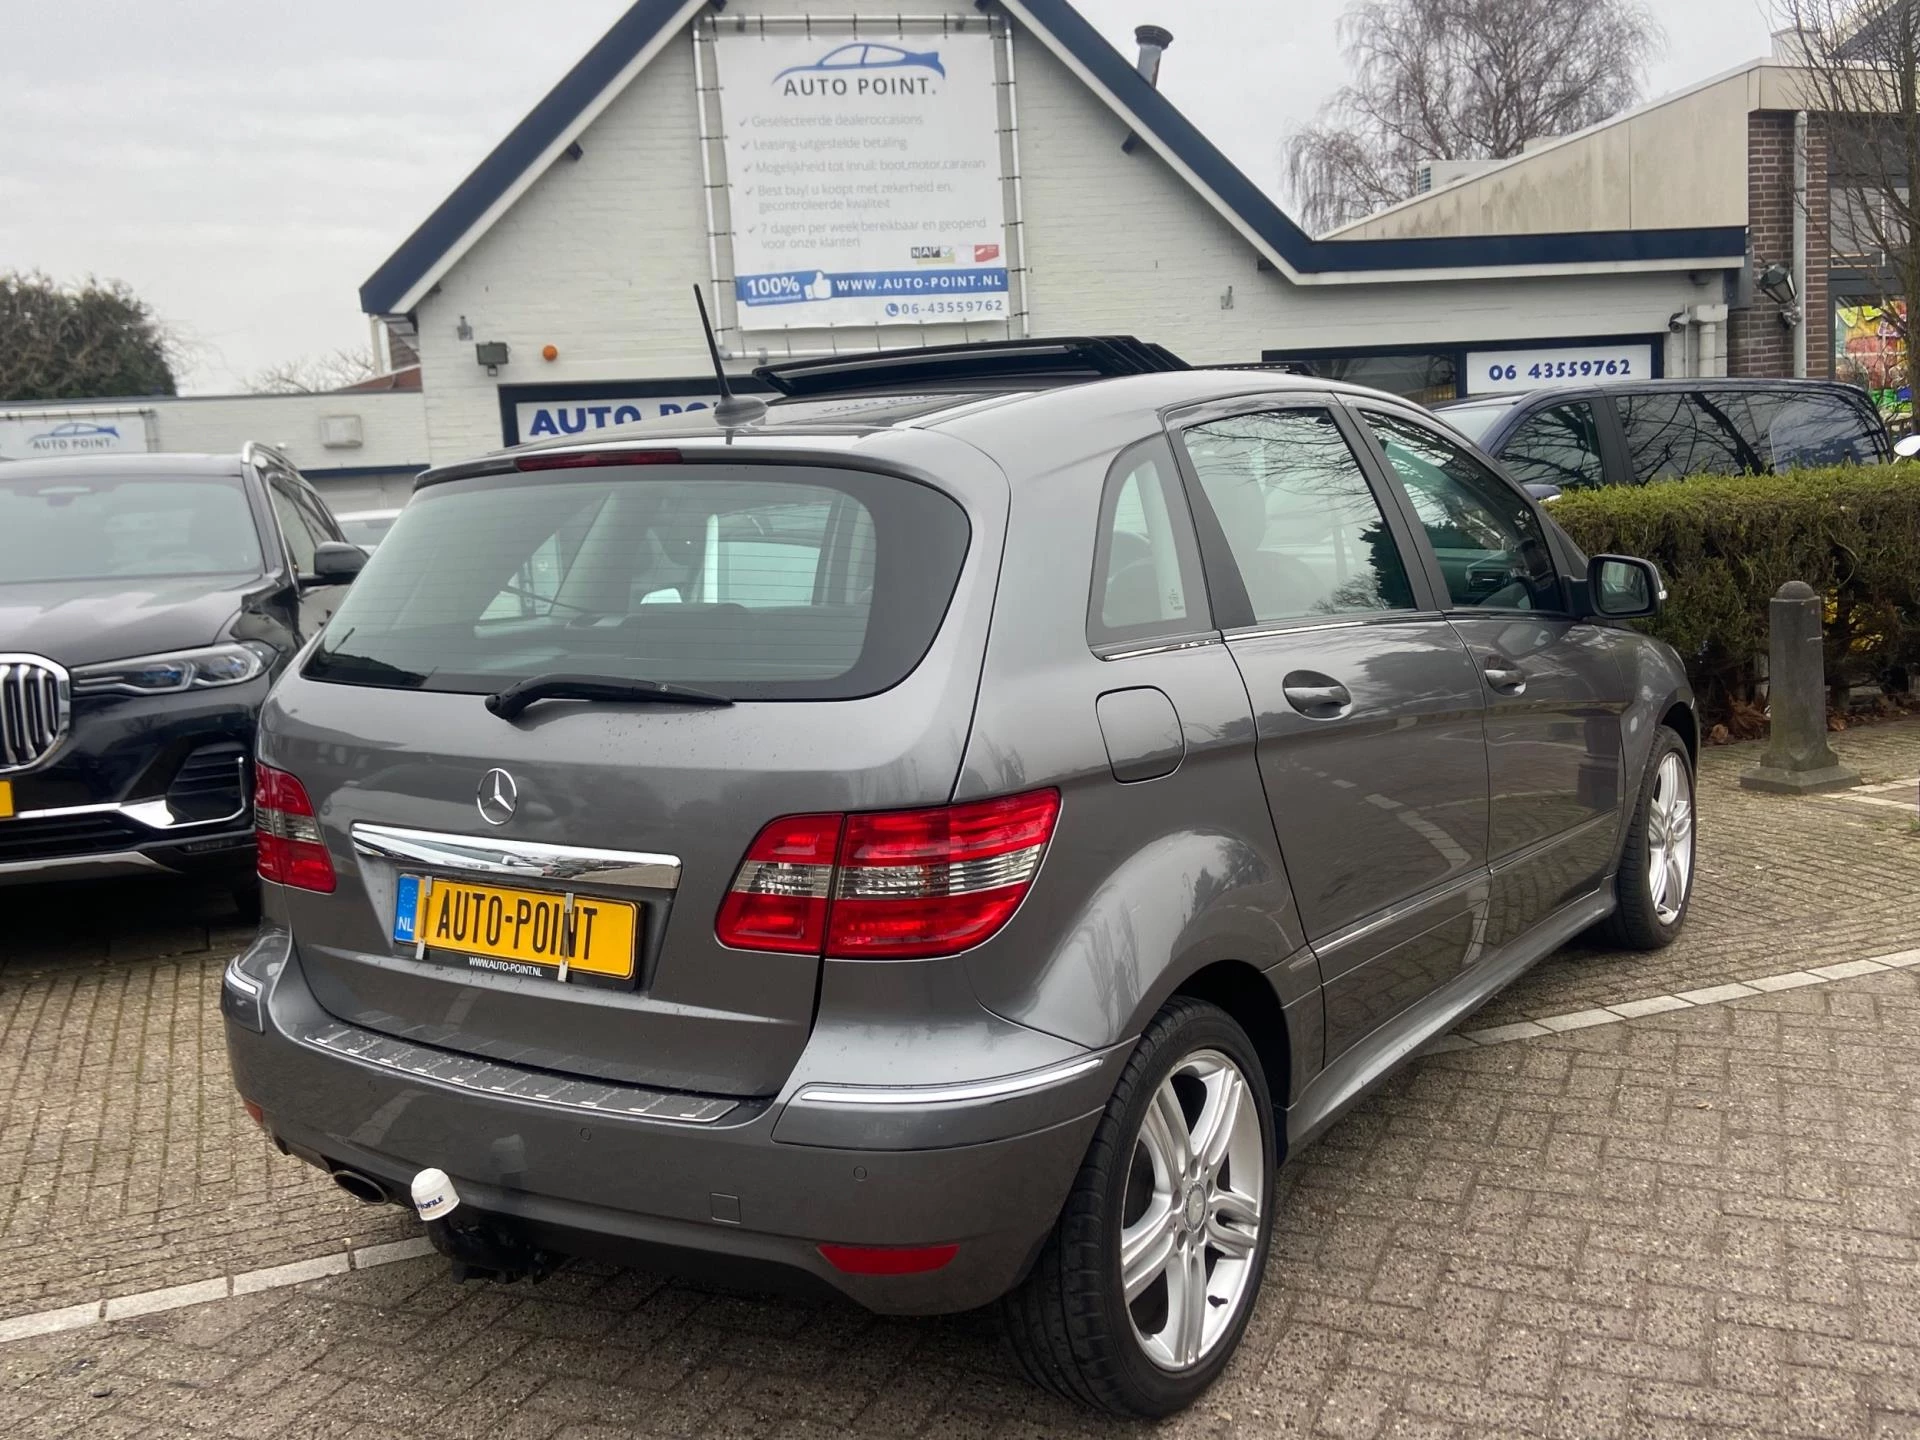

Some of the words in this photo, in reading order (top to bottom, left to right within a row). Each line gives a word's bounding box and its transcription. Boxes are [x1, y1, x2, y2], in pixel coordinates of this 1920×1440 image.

[783, 78, 848, 97] AUTO
[857, 76, 937, 96] POINT.
[856, 182, 878, 194] met
[881, 180, 934, 194] zekerheid
[758, 199, 844, 215] gecontroleerde
[761, 224, 768, 235] 7
[770, 223, 806, 237] dagen
[809, 223, 827, 237] per
[830, 220, 859, 233] week
[922, 219, 936, 230] en
[938, 217, 987, 231] geopend
[790, 236, 817, 247] onze
[747, 276, 801, 296] 100%
[836, 275, 1002, 291] WWW.AUTO-POINT.NL
[901, 300, 1004, 315] 06-43559762
[1489, 364, 1517, 381] 06
[1528, 358, 1631, 379] 43559762
[33, 440, 68, 450] AUTO
[398, 916, 414, 932] NL
[436, 888, 598, 960] AUTO-POINT
